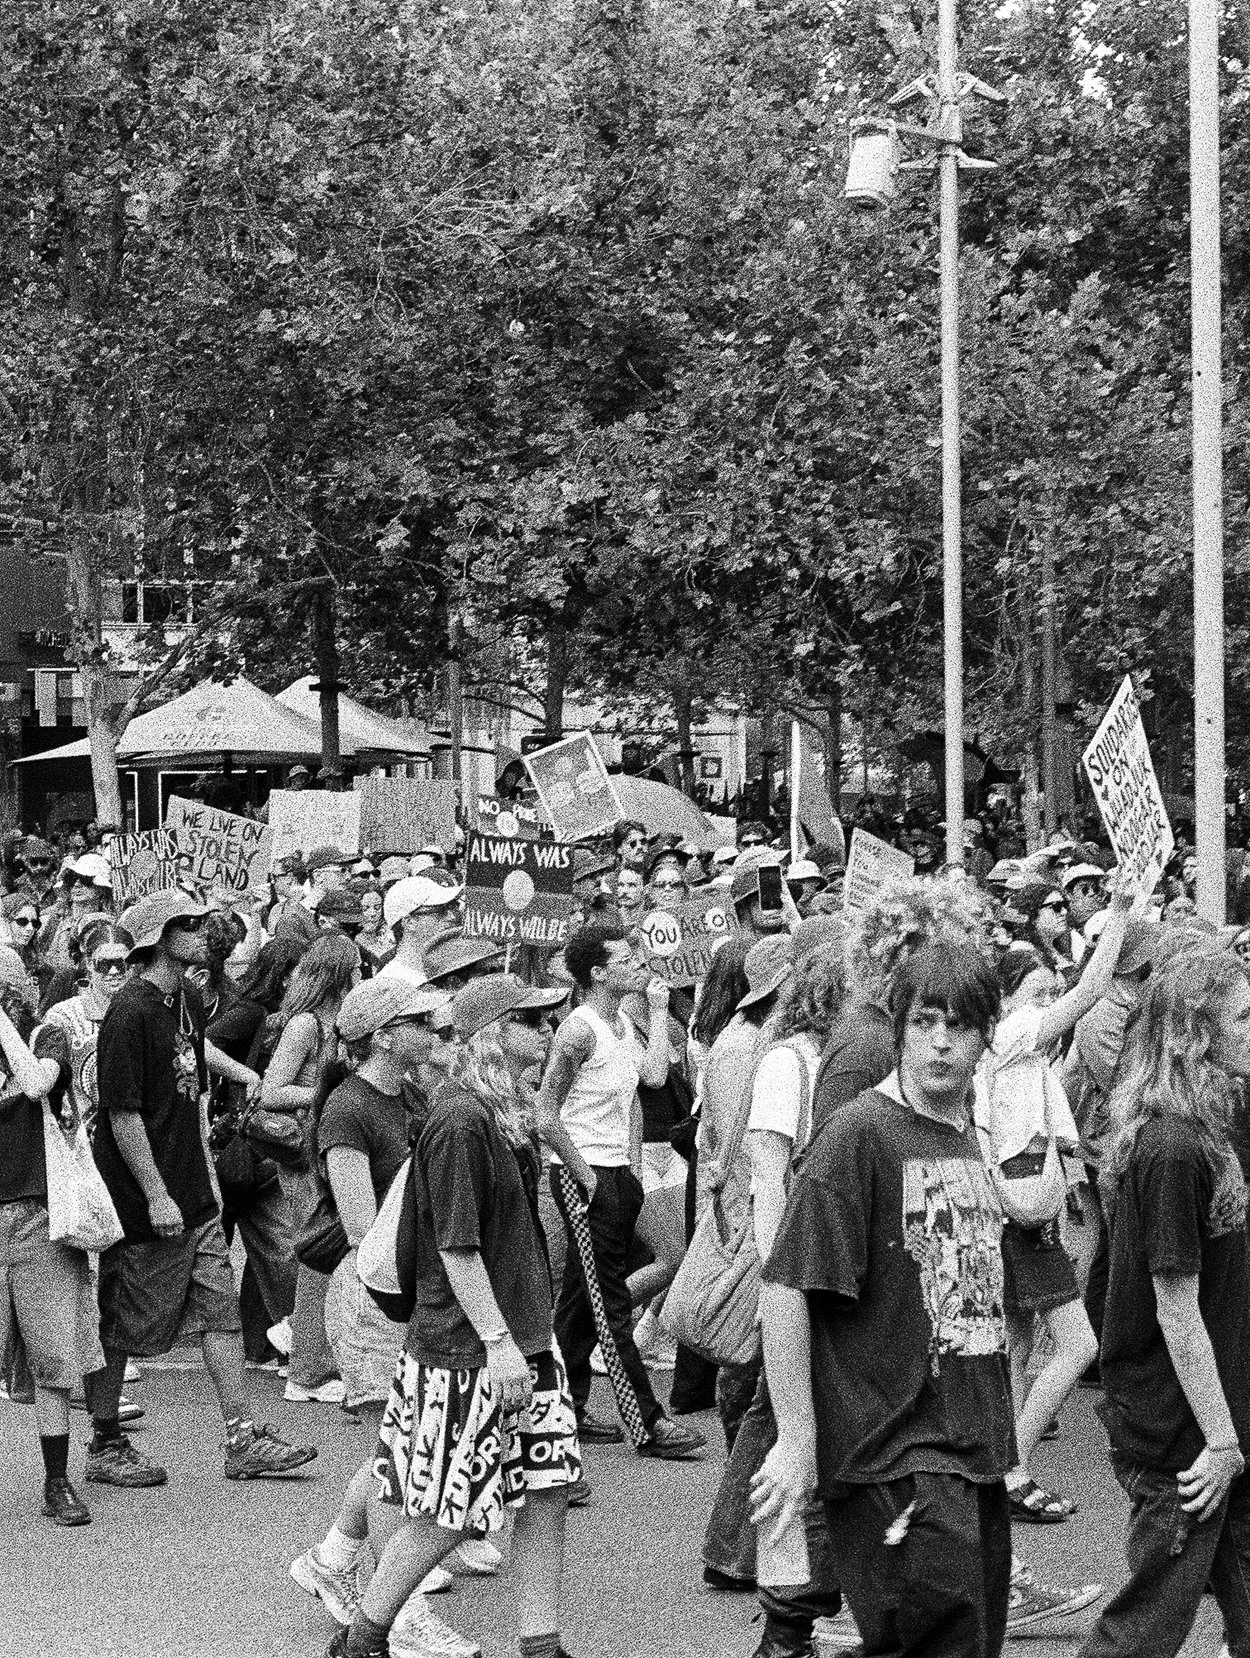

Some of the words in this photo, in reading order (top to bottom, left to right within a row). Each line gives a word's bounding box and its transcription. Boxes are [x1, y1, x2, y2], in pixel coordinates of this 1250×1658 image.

[1114, 748, 1129, 784] ON
[478, 799, 500, 816] NO
[182, 809, 205, 829] WE
[209, 815, 241, 838] LIVE
[242, 822, 265, 844] ON
[151, 829, 178, 860] WAS
[188, 829, 260, 868] STOLEN
[470, 838, 528, 866] ALWAYS
[533, 844, 570, 869] WAS
[198, 855, 249, 891] LAND
[463, 908, 516, 938] ALWAYS
[641, 923, 677, 949] YOU
[681, 914, 711, 940] ARE
[712, 912, 740, 931] ON
